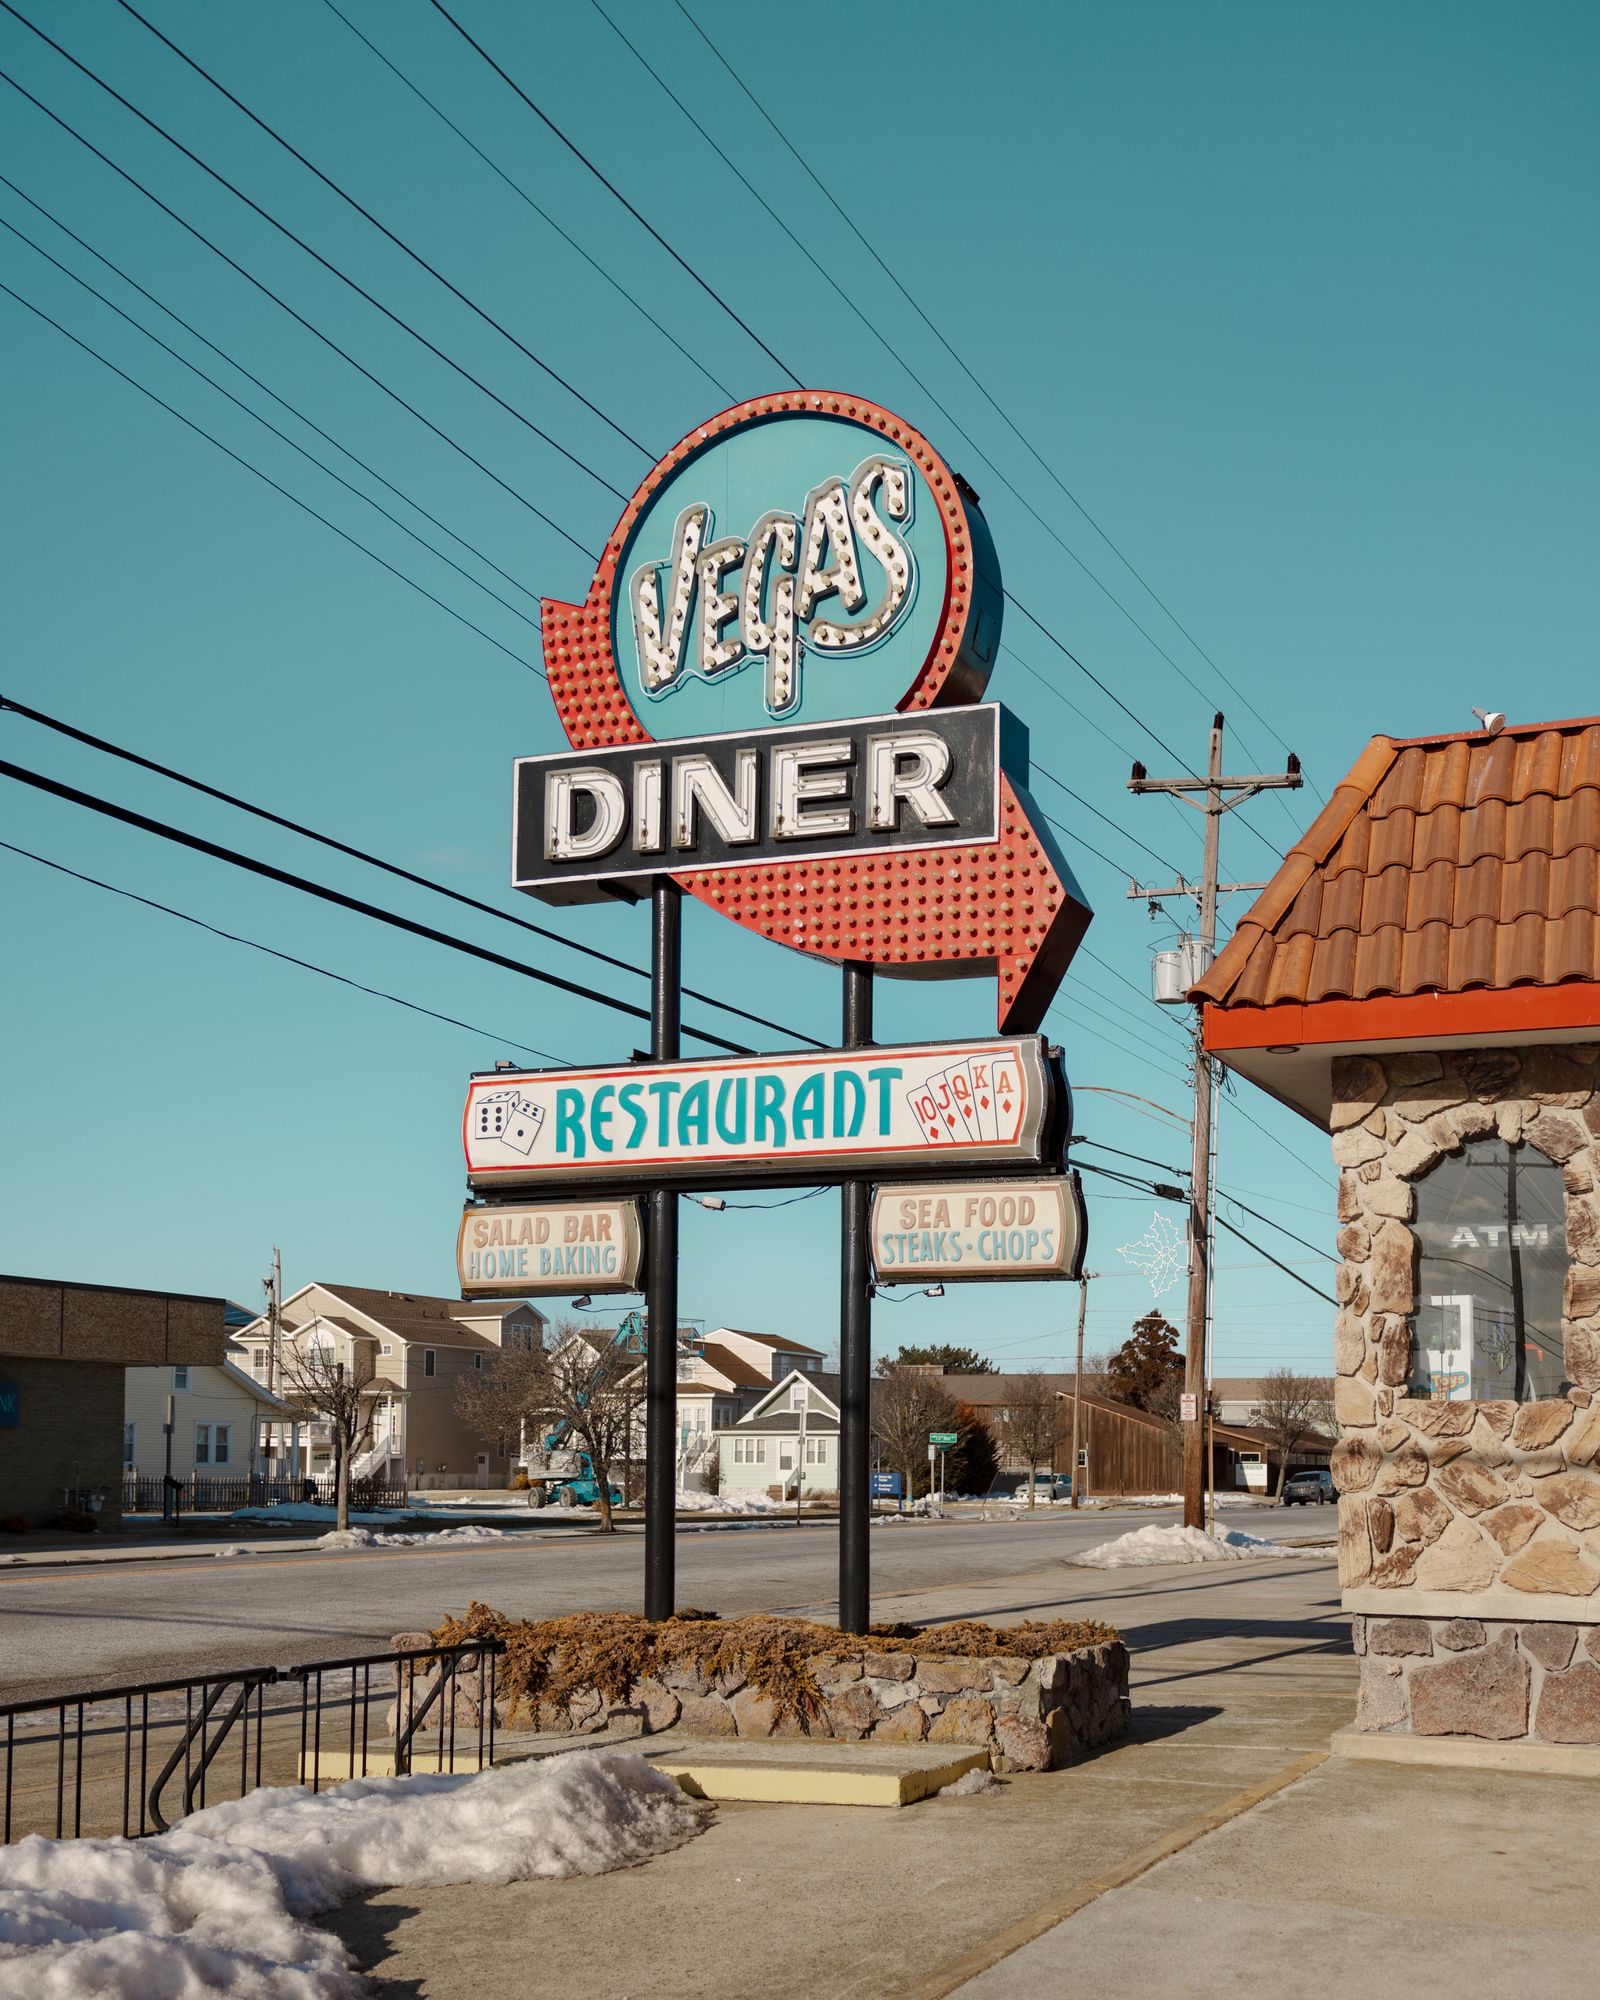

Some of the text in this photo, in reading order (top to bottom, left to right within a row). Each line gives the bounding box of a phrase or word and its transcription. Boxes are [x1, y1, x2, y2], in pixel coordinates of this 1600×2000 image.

[544, 728, 959, 861] DINER
[915, 1096, 937, 1124] 10
[953, 1075, 971, 1100] Q
[973, 1065, 989, 1089] K
[996, 1071, 1014, 1094] A
[555, 1067, 903, 1158] RESTAURANT
[900, 1195, 1036, 1230] SEA FOOD
[473, 1213, 612, 1248] SALAD BAR
[1449, 1223, 1549, 1248] ATM
[469, 1245, 617, 1280] HOME BAKING
[1430, 1374, 1466, 1390] Toys
